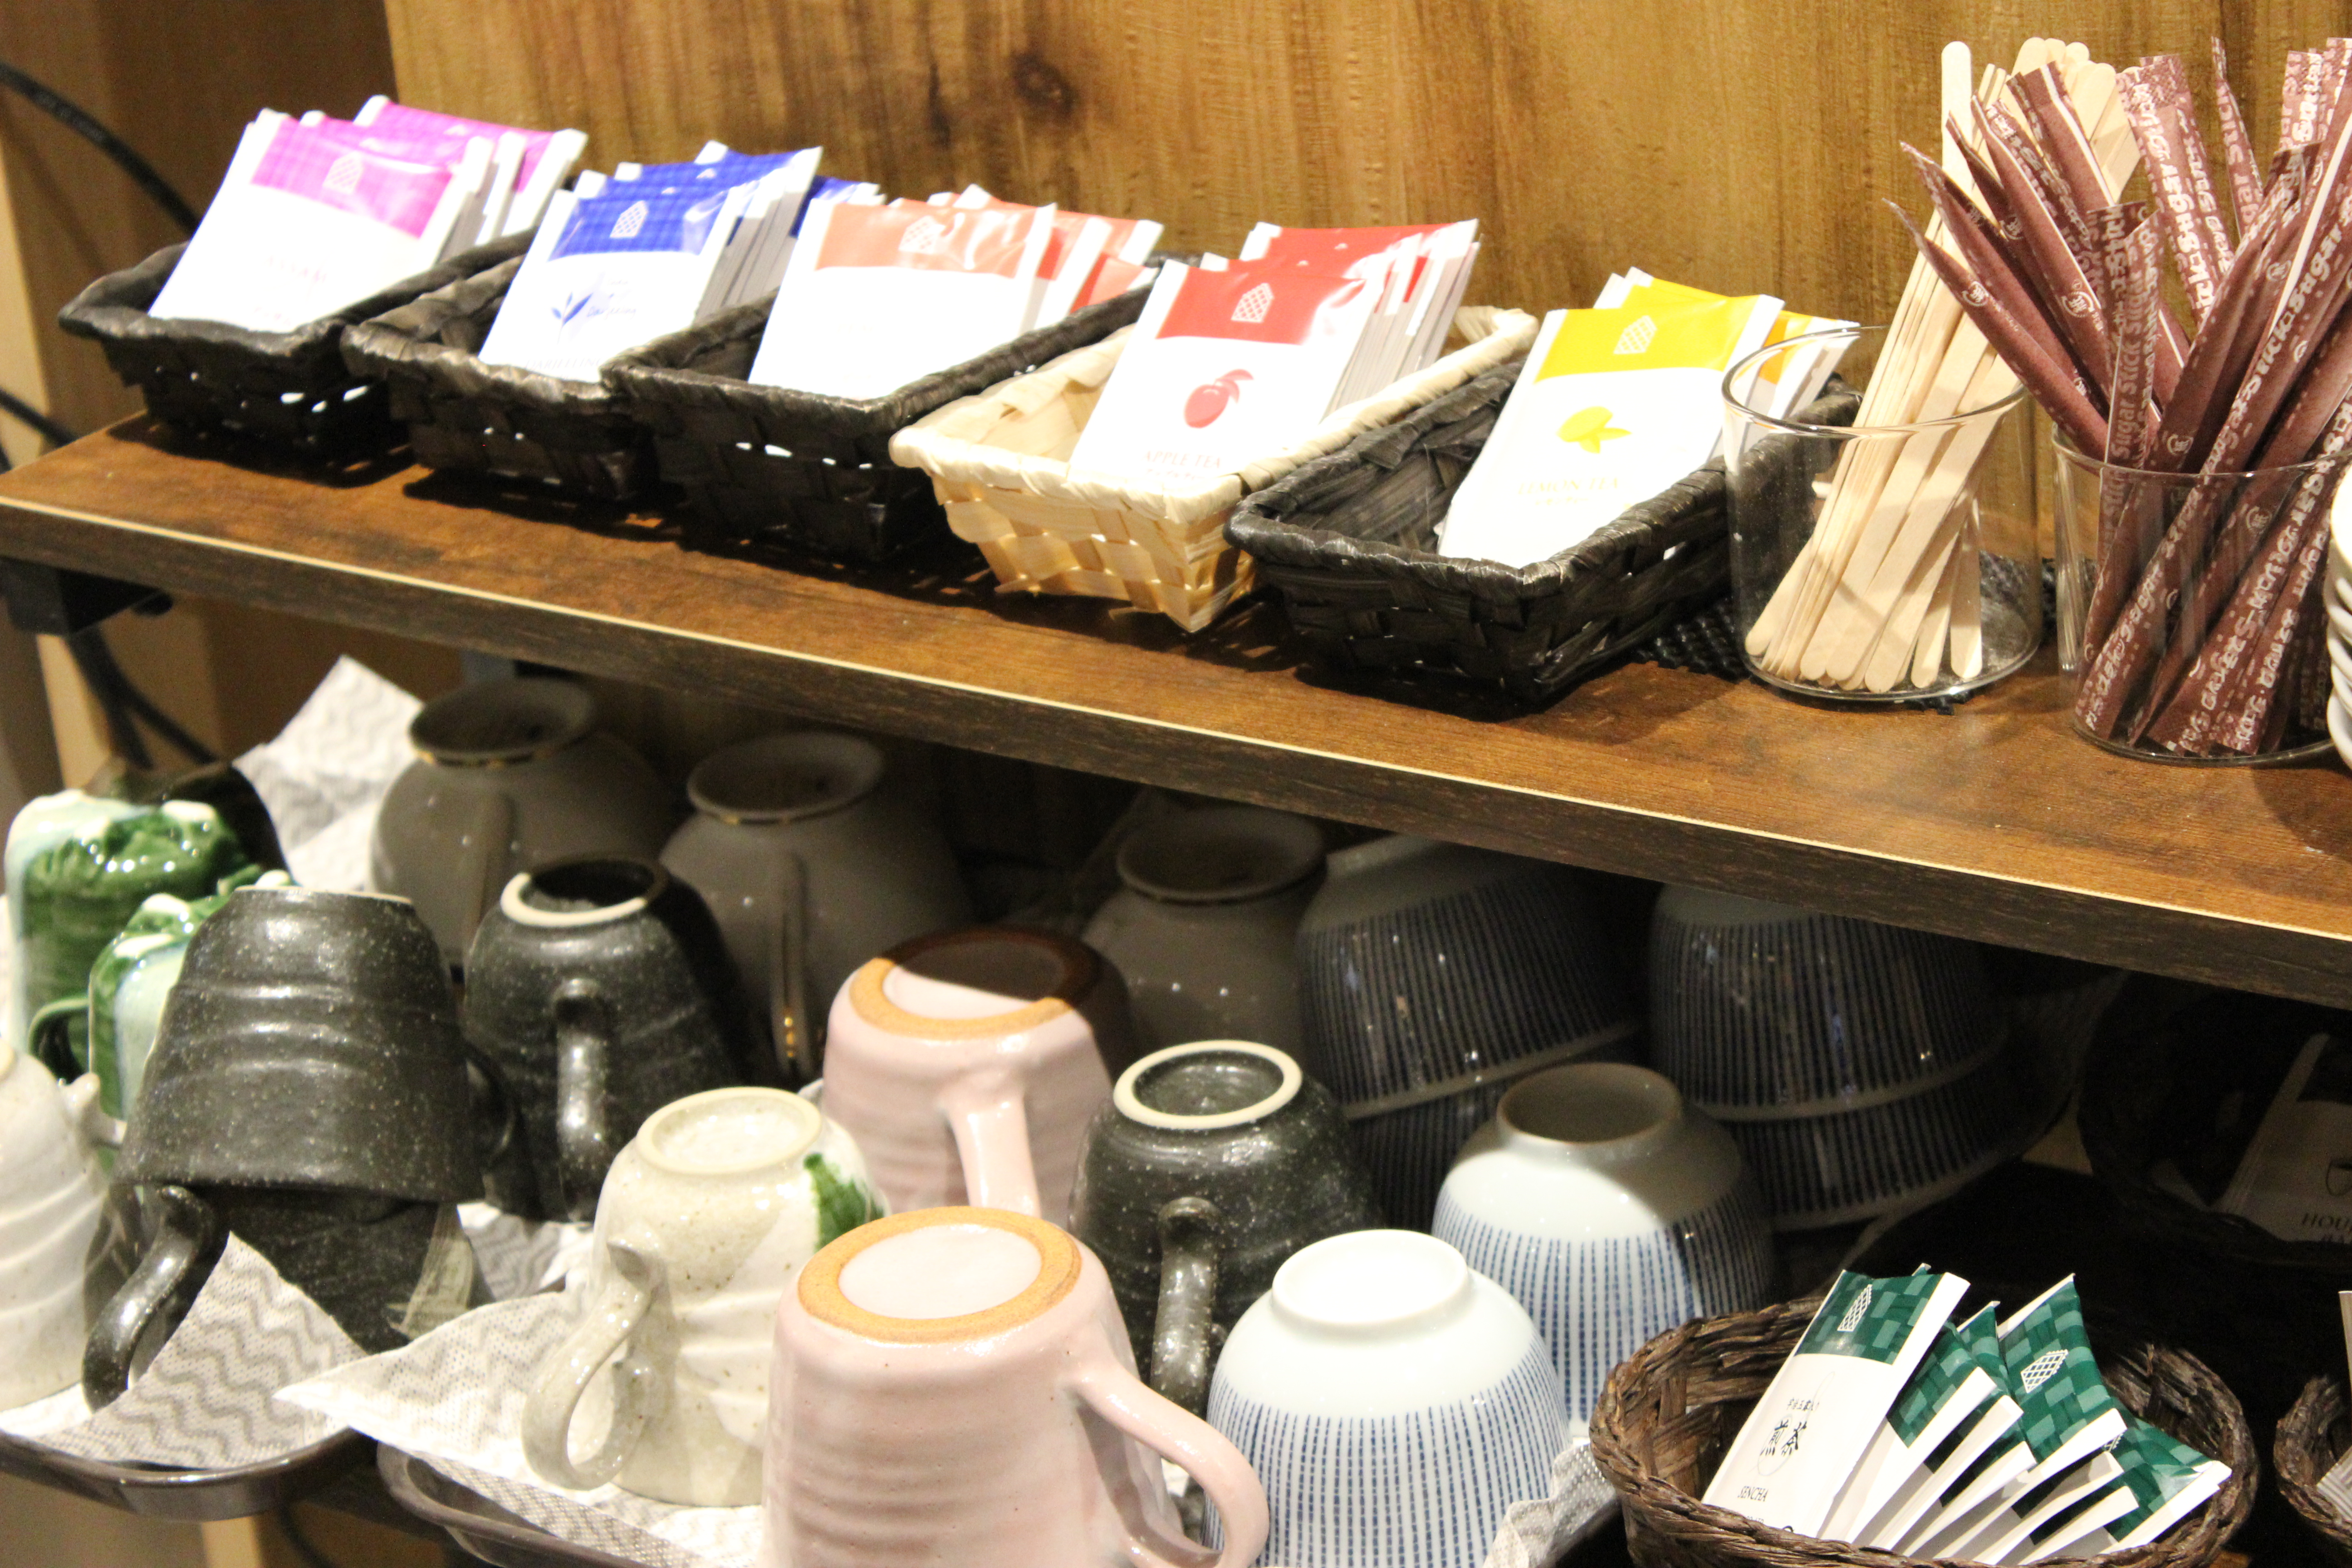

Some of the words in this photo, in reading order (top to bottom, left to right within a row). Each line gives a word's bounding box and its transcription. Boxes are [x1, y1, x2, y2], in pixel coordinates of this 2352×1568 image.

[2214, 85, 2246, 164] Stick
[2114, 338, 2143, 395] Stick
[2108, 398, 2138, 459] Sugar
[1140, 450, 1191, 466] APPLE
[1194, 454, 1221, 469] TEA
[1517, 478, 1583, 495] LEMON
[1588, 476, 1619, 490] TEA
[1760, 1419, 1808, 1456] 煎茶
[1737, 1485, 1769, 1502] SENCHA
